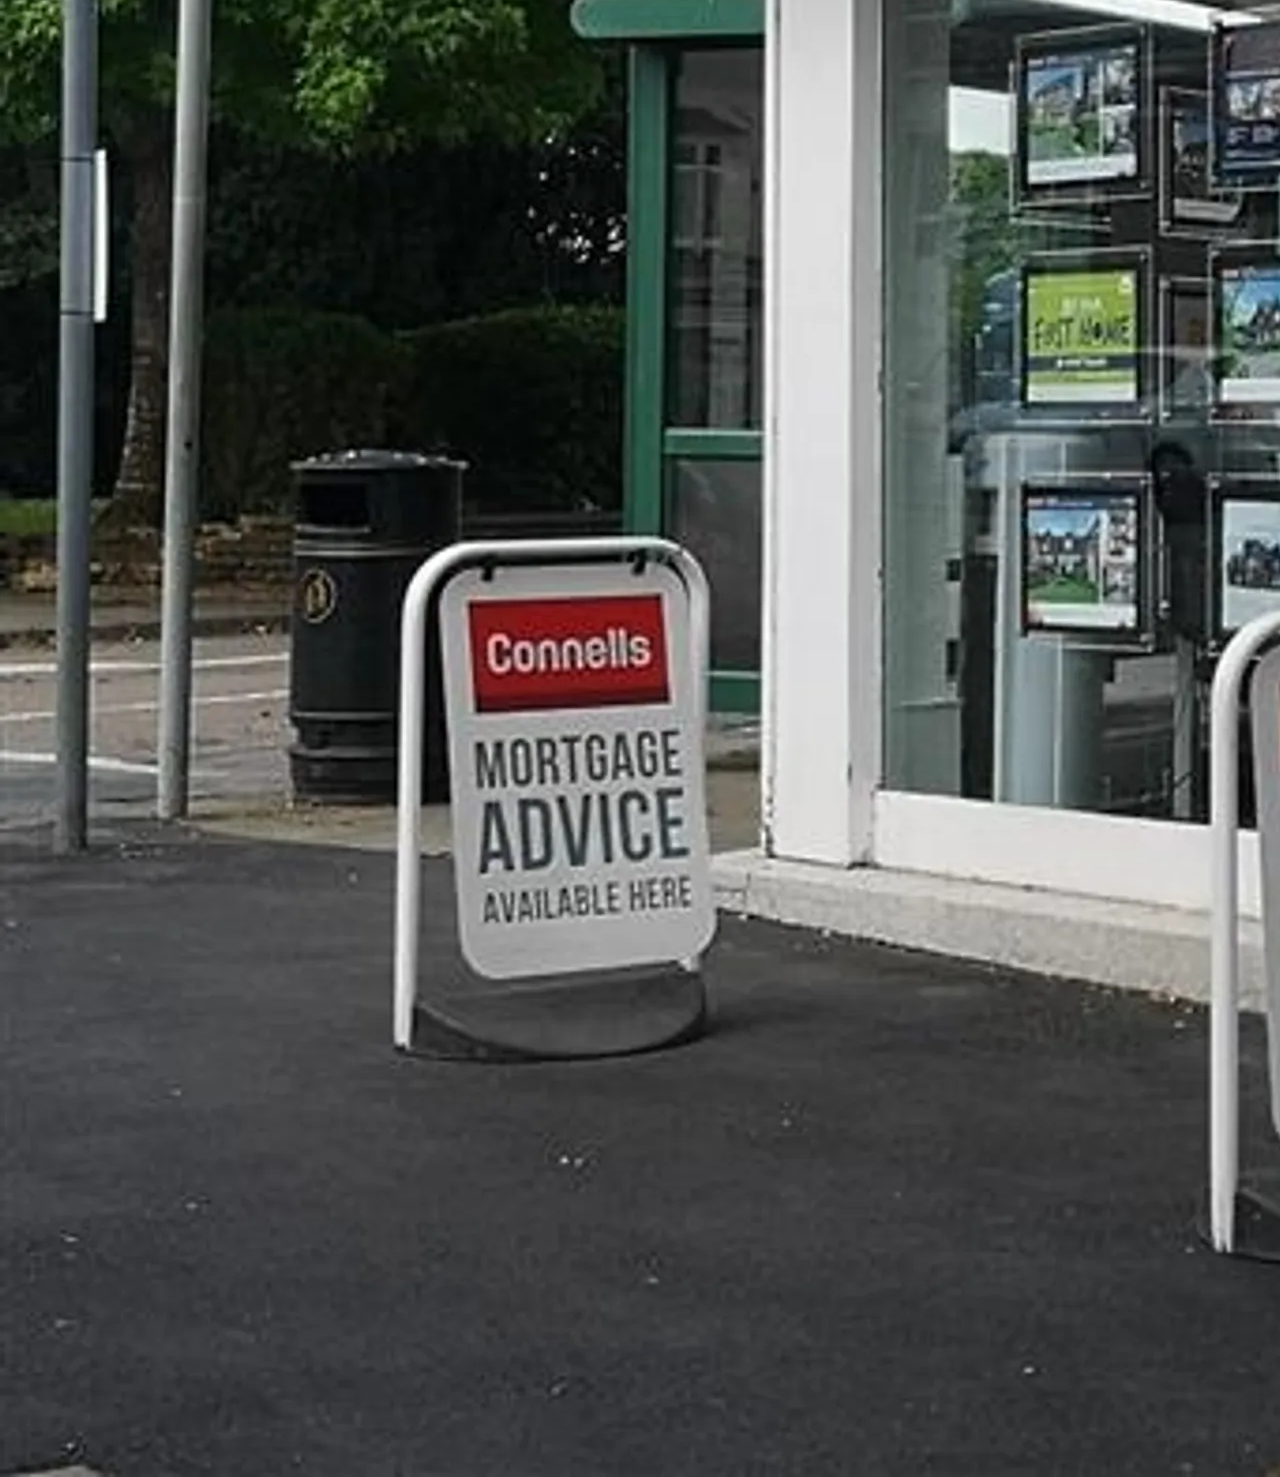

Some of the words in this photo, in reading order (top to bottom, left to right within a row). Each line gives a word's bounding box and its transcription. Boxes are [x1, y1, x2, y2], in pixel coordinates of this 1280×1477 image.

[486, 628, 652, 675] Connells
[474, 729, 684, 791] MORTGAGE
[479, 788, 691, 876] ADVICE
[482, 882, 622, 924] AVAILABLE
[629, 875, 693, 912] HERE
